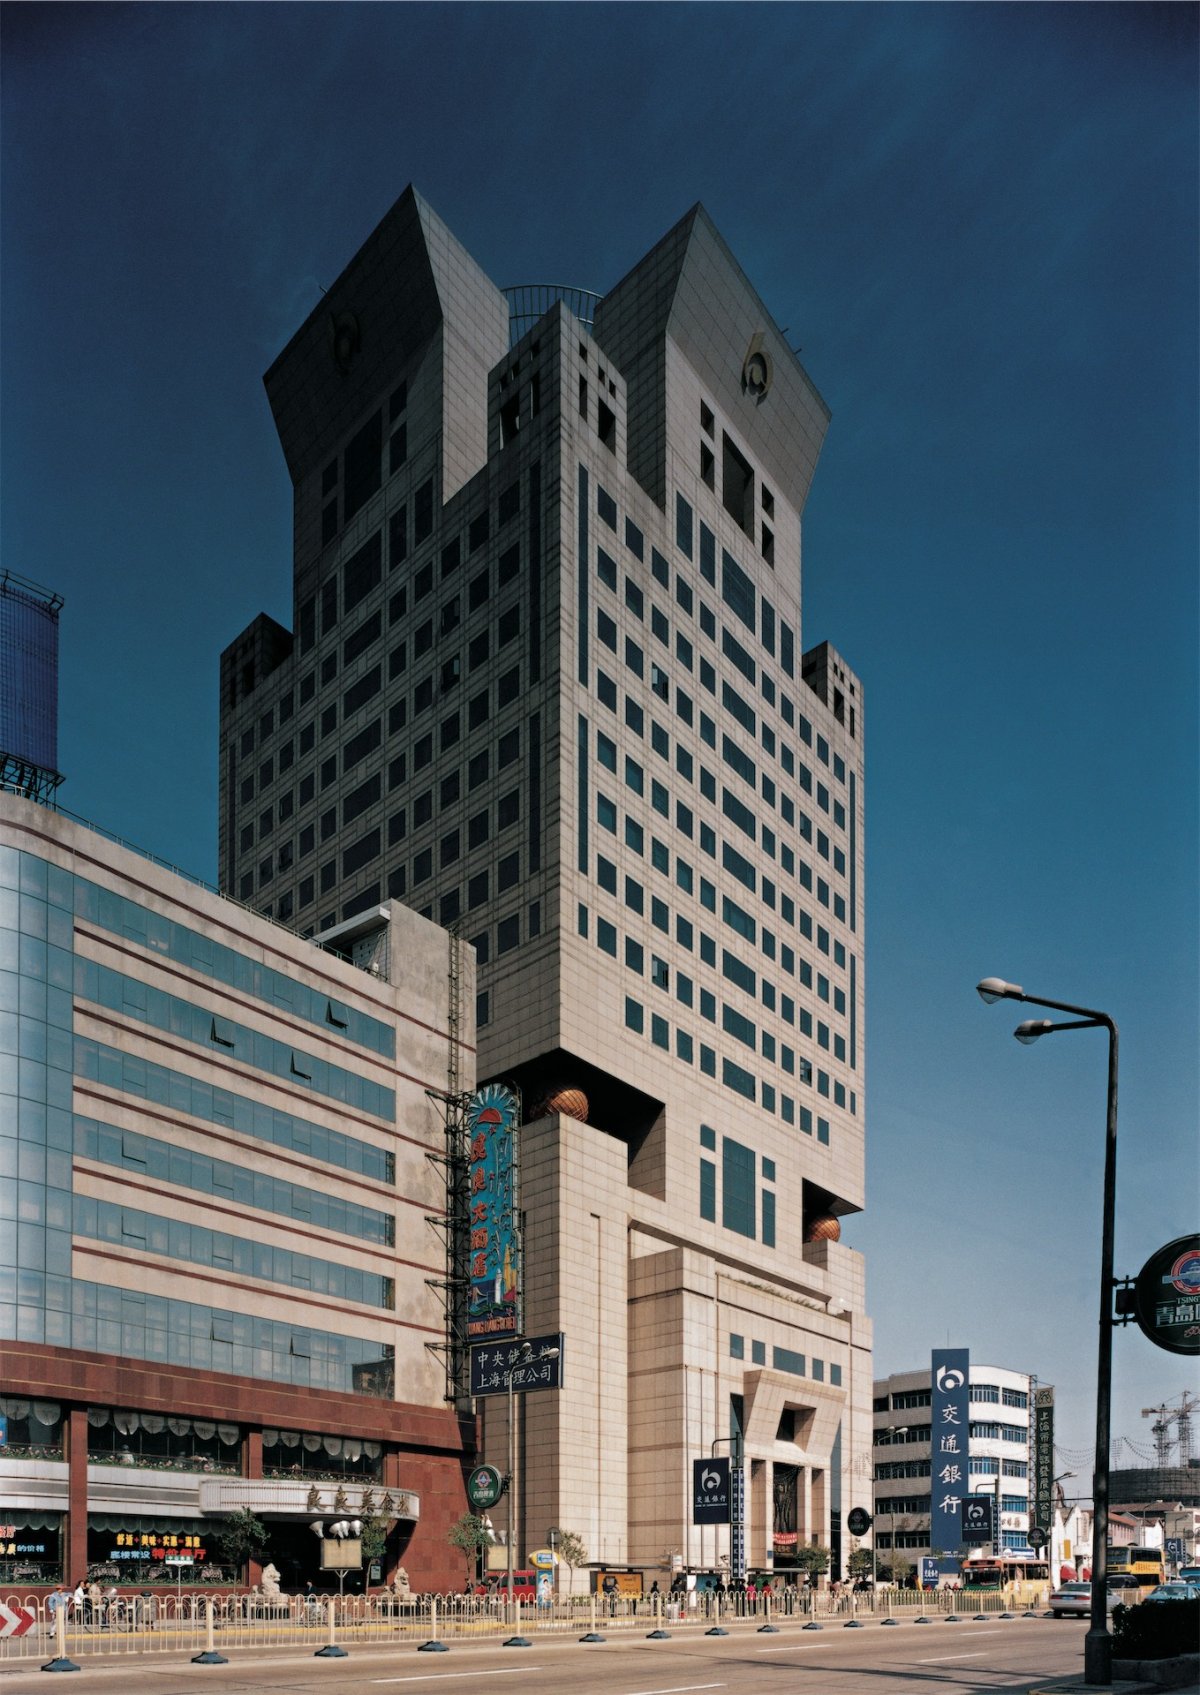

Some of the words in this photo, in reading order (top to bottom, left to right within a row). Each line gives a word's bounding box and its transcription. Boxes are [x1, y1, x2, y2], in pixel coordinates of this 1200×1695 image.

[1176, 1295, 1200, 1304] TSING
[477, 1365, 551, 1389] 上海管理公司
[938, 1404, 962, 1514] 交通銀行
